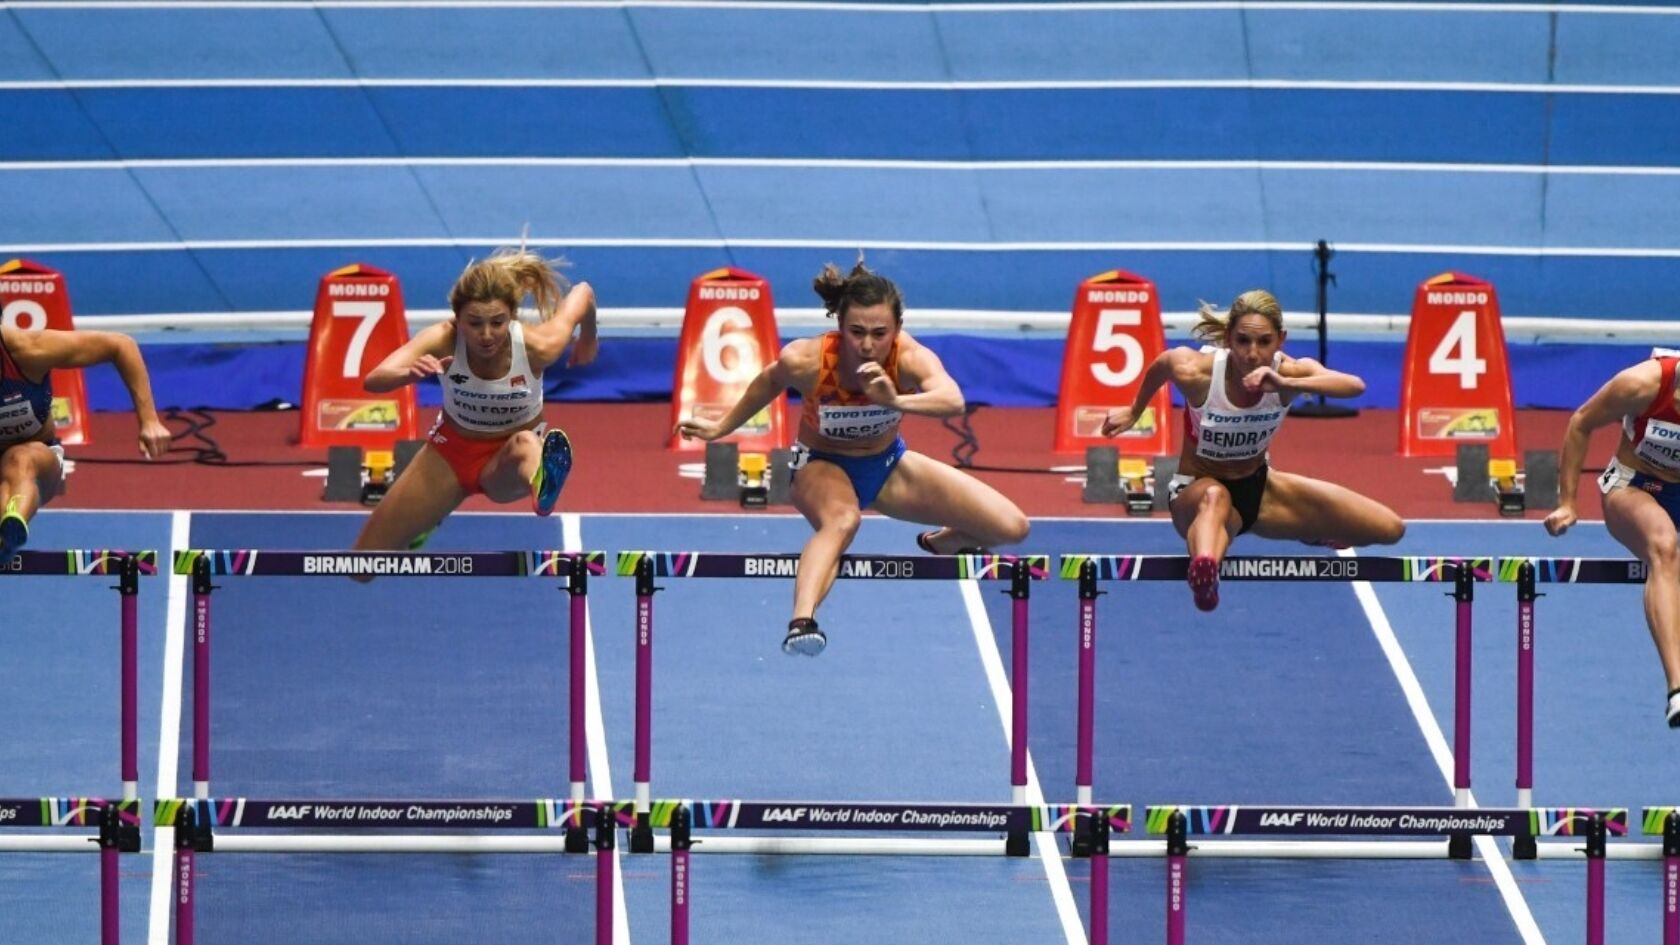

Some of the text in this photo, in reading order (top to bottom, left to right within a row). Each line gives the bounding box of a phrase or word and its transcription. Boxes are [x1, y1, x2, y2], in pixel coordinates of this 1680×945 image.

[329, 283, 390, 297] MONDO
[699, 288, 760, 301] MONDO
[1087, 290, 1149, 304] MONDO
[1427, 292, 1488, 305] MONDO
[332, 301, 386, 378] 7
[702, 306, 756, 384] 6
[1090, 309, 1144, 387] 5
[1428, 311, 1487, 389] 4
[453, 387, 488, 400] TOYO
[824, 409, 895, 419] TOYO TIRE
[1207, 412, 1280, 423] TOYO TIRES
[304, 556, 473, 574] BIRMINGHAM 2018
[744, 558, 914, 578] BIRMIAM 2018
[1319, 560, 1358, 578] 2018
[267, 806, 312, 819] IAAF
[314, 806, 353, 820] World
[358, 806, 404, 820] Indoor
[762, 808, 807, 821] IAAF
[809, 808, 849, 822] World
[852, 809, 899, 824] Indoor
[1260, 813, 1304, 826] IAAF
[1306, 813, 1346, 827] World
[1350, 814, 1396, 828] Indoor
